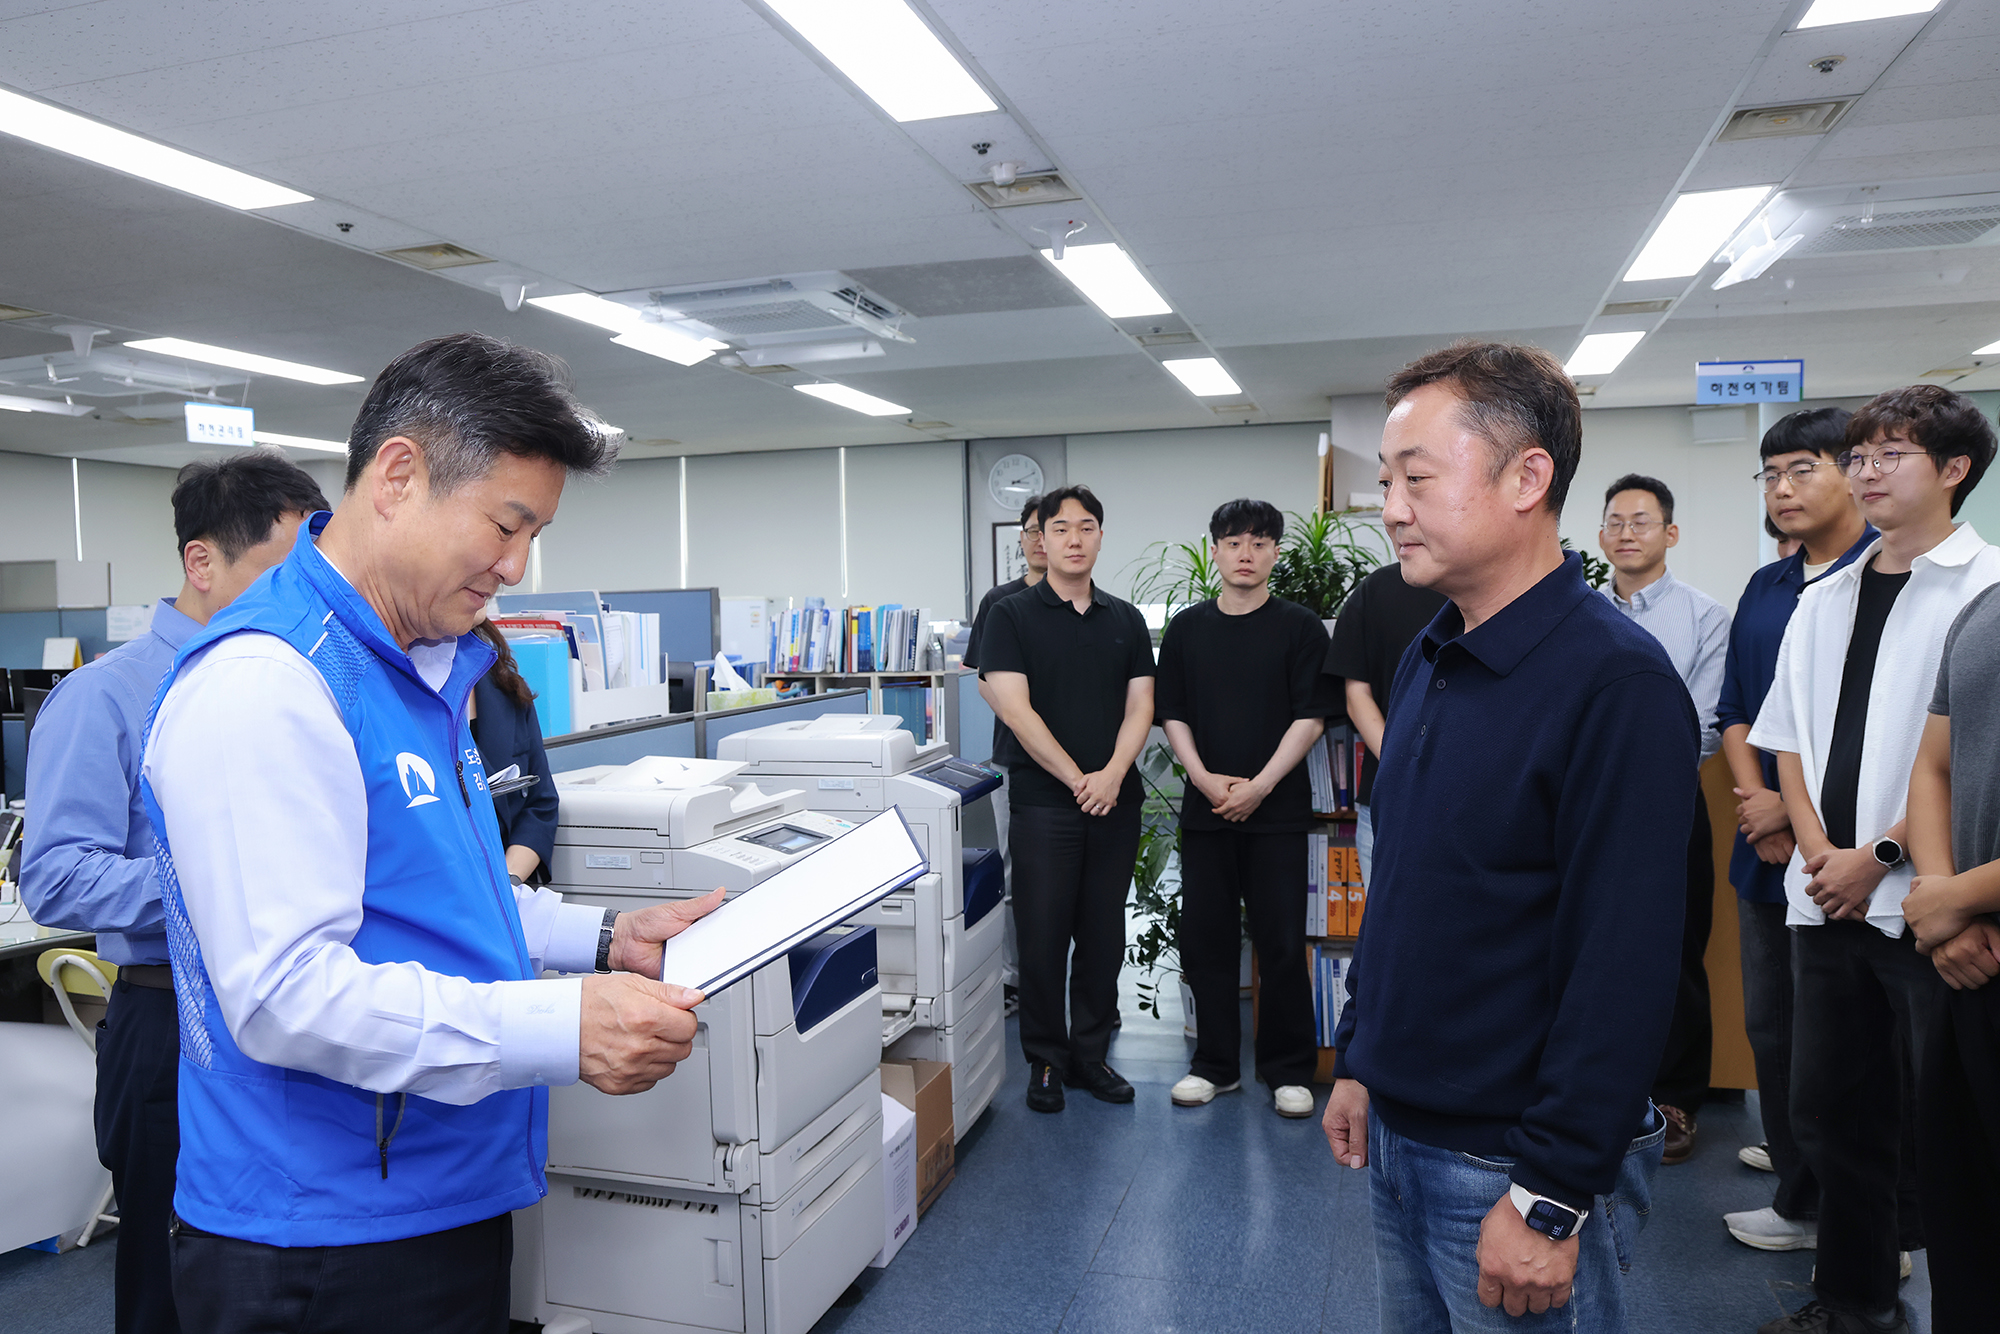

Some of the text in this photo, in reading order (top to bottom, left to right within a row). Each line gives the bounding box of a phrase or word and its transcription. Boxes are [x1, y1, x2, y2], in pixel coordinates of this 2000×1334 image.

[1710, 380, 1789, 396] 하천여가팀
[1328, 890, 1342, 902] 4
[1348, 891, 1362, 902] 5
